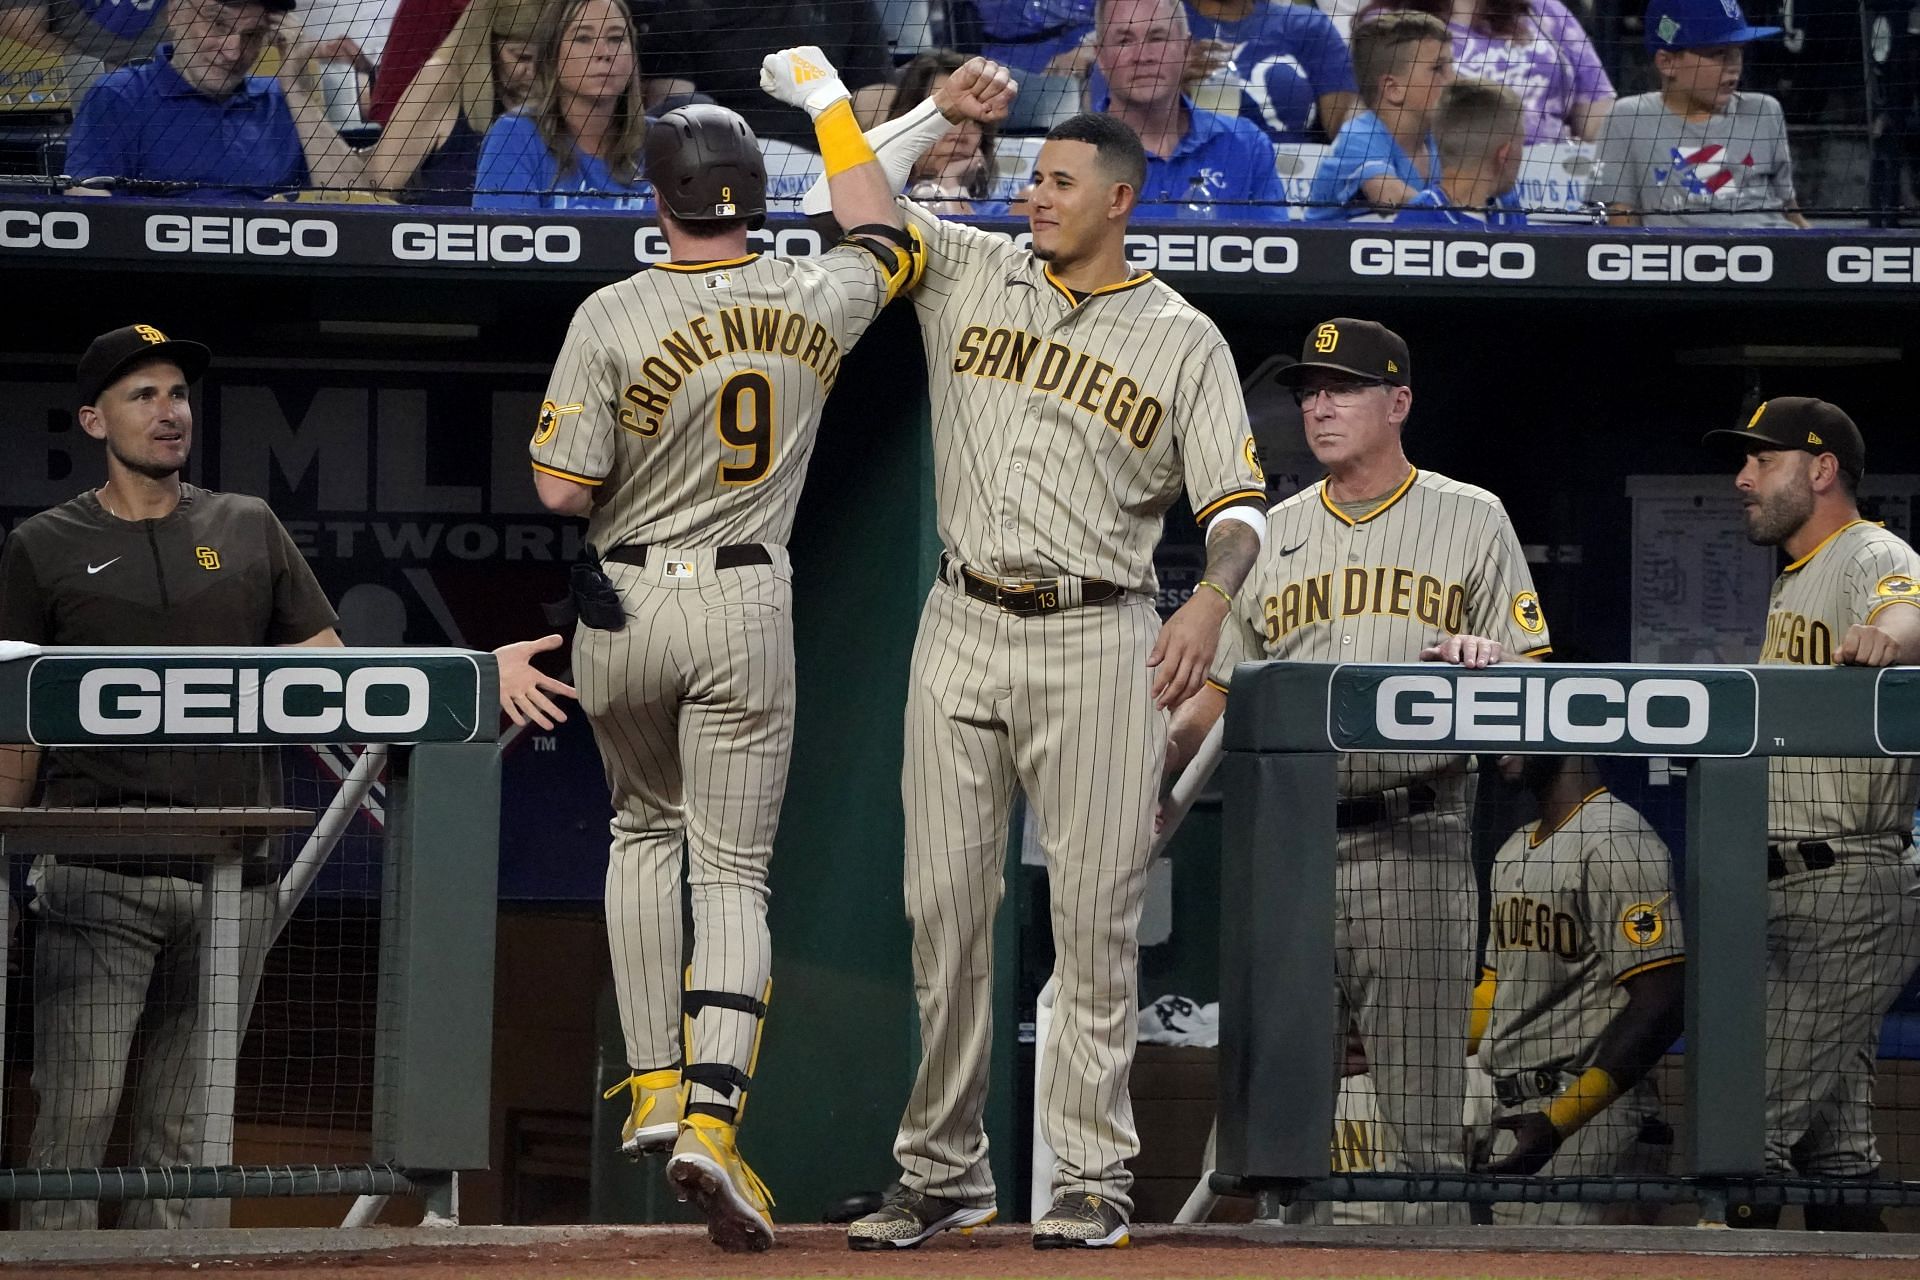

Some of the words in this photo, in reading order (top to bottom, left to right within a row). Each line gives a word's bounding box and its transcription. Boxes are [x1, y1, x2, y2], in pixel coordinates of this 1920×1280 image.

[721, 186, 732, 202] 9
[145, 214, 338, 257] GEICO
[391, 222, 581, 263] GEICO
[634, 225, 822, 263] GCO
[1125, 234, 1299, 275] GEICO
[1350, 238, 1536, 280] GEICO
[1587, 244, 1774, 283] GEICO
[1314, 323, 1340, 353] SD
[953, 325, 1044, 385] SAN
[1033, 339, 1166, 451] DIEGO
[716, 368, 774, 487] 9
[195, 546, 221, 571] SD
[1038, 592, 1056, 609] 13
[1264, 572, 1334, 645] SAN
[1340, 566, 1466, 636] DIEGO
[78, 666, 430, 735] GEICO
[1375, 675, 1710, 745] GEICO
[531, 736, 557, 751] TM
